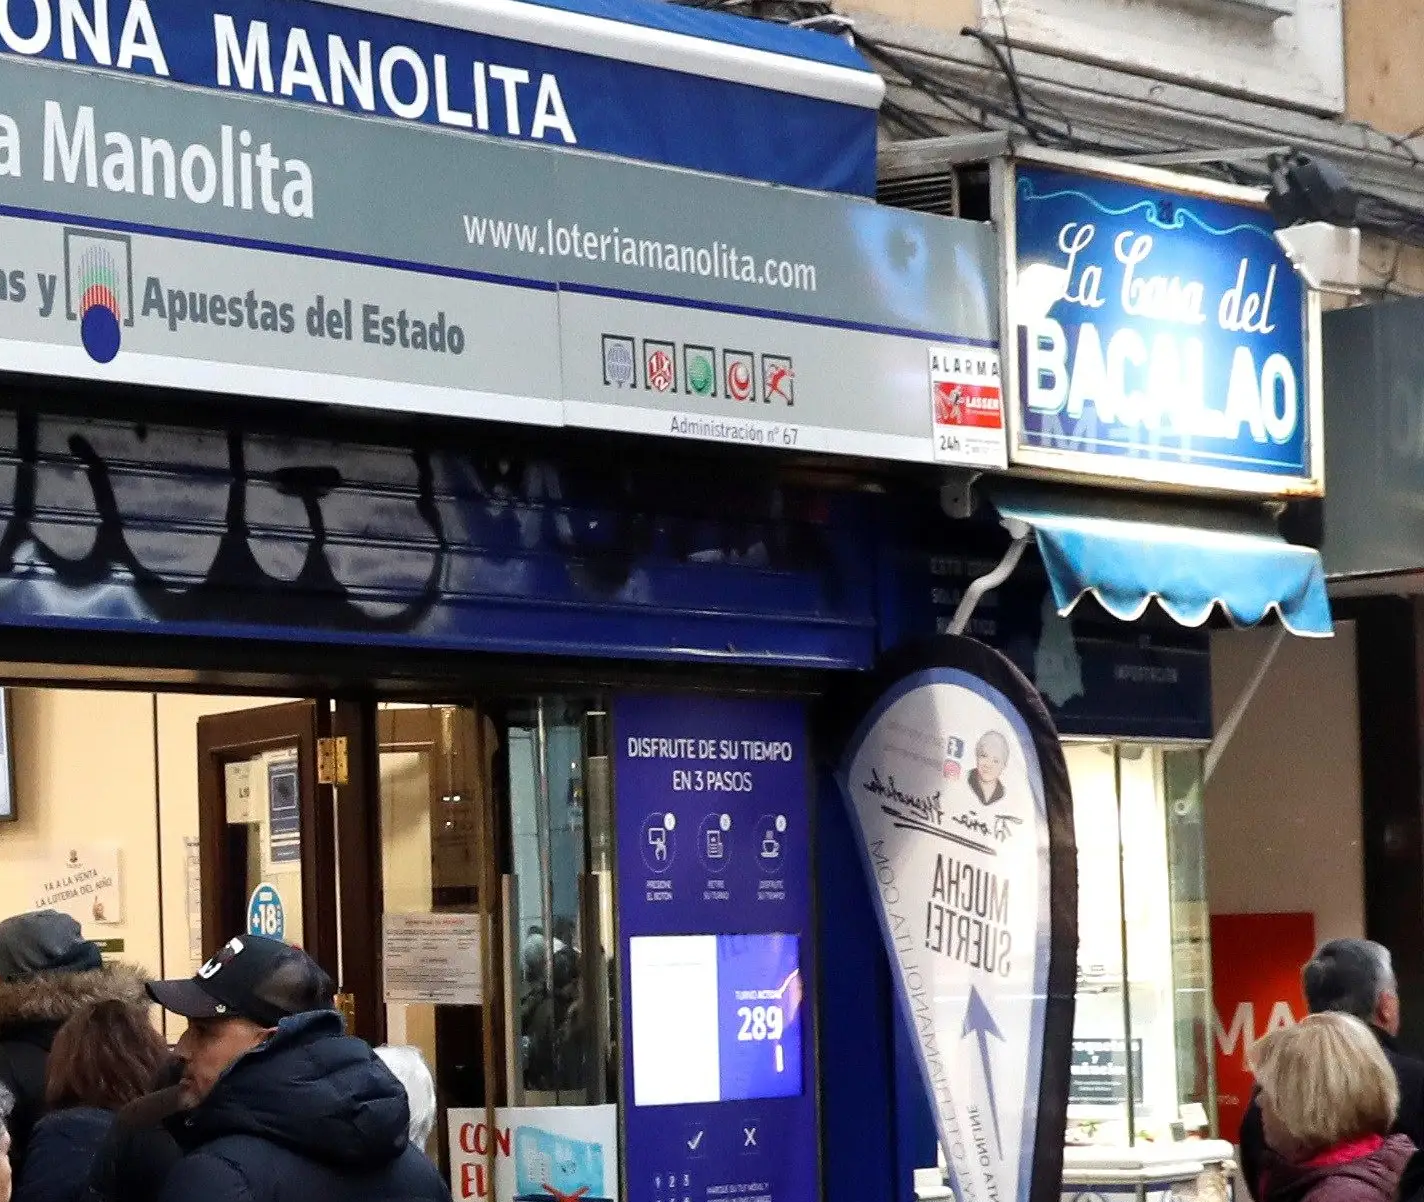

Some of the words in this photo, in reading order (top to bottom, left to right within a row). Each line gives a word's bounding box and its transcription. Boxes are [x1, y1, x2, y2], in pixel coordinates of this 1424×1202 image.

[213, 13, 577, 144] MANOLITA
[43, 100, 314, 219] Manolita
[463, 212, 816, 292] www.loteriamanolita.com
[38, 273, 57, 317] y
[1050, 222, 1105, 308] La
[1114, 230, 1206, 323] Casa
[1218, 258, 1276, 334] del
[141, 276, 294, 333] Apuestas
[306, 296, 352, 341] del
[362, 301, 465, 355] Estado
[932, 355, 1000, 376] ALARMA
[1027, 318, 1297, 446] BACALAO
[783, 428, 799, 445] 67
[627, 737, 695, 759] DISFRUTE
[698, 740, 717, 759] DE
[719, 740, 739, 760] SU
[741, 741, 793, 762] TIEMPO
[672, 770, 691, 791] EN
[694, 770, 703, 791] 3
[706, 771, 753, 792] PASOS
[252, 903, 278, 936] +18
[736, 1005, 784, 1041] 289
[459, 1121, 511, 1158] CON
[669, 1175, 676, 1188] 2
